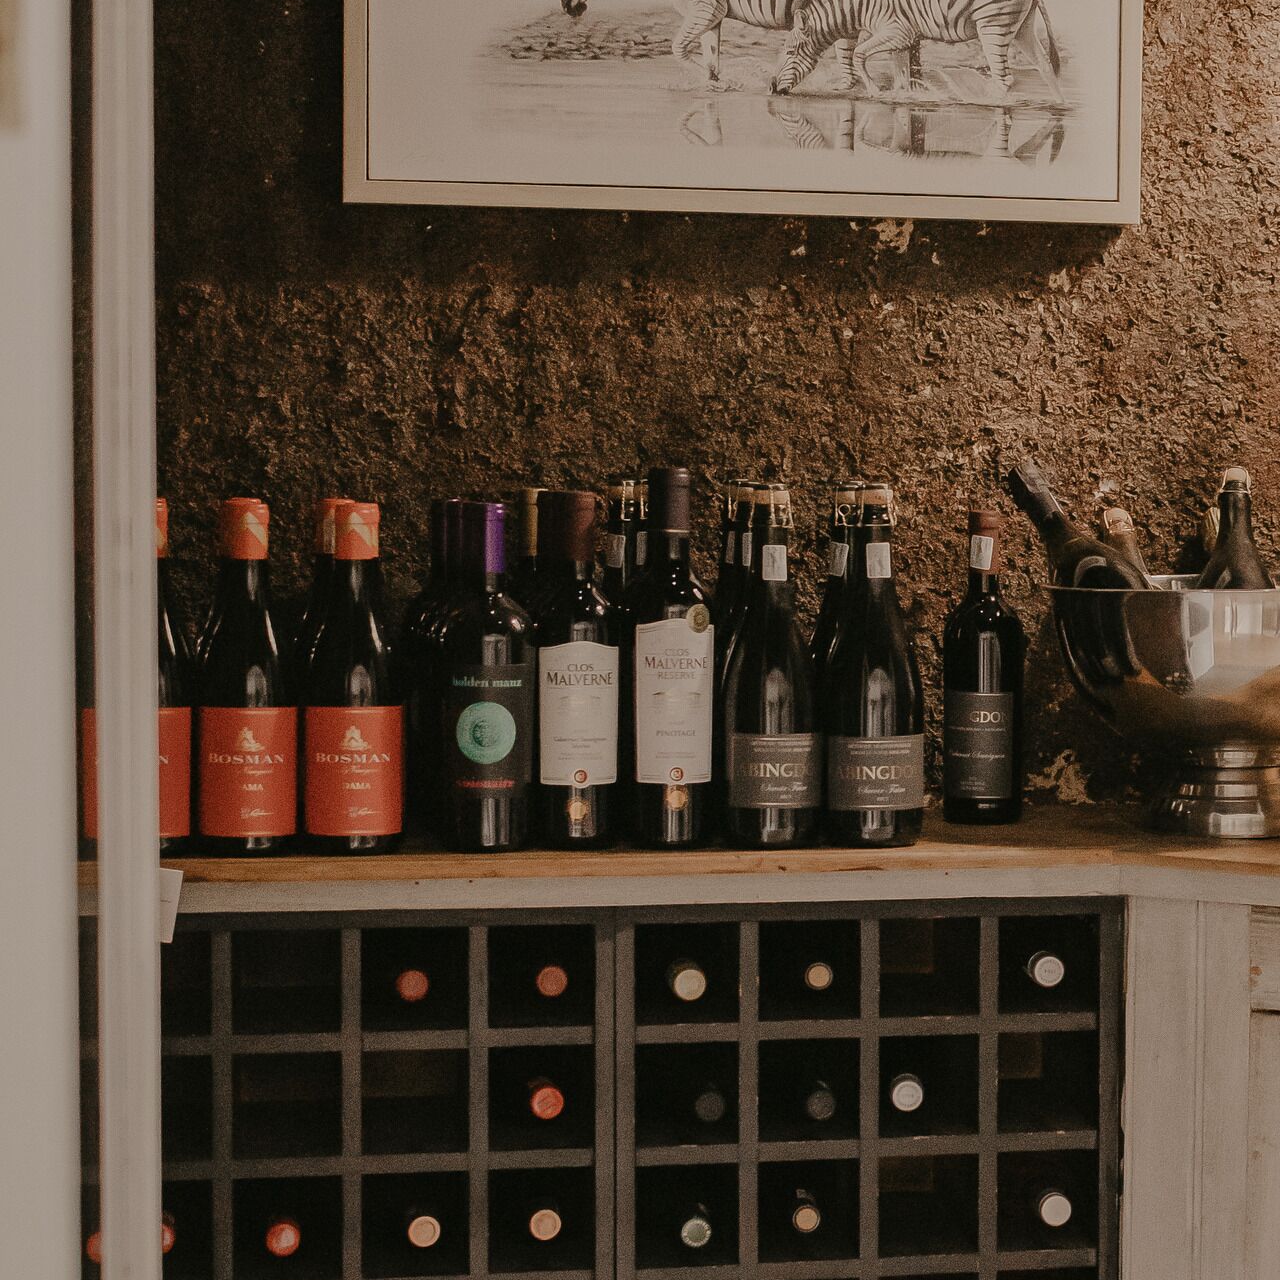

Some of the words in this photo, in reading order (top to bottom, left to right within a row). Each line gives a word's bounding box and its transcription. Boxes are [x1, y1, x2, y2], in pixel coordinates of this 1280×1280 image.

[567, 663, 594, 672] CLOS
[644, 656, 708, 670] MALVERNE
[546, 671, 613, 686] MALVERNE
[657, 672, 696, 680] RESERVE
[655, 729, 697, 737] PINOTAGE
[208, 753, 284, 765] BOSMAN
[315, 752, 390, 763] BOSMAN
